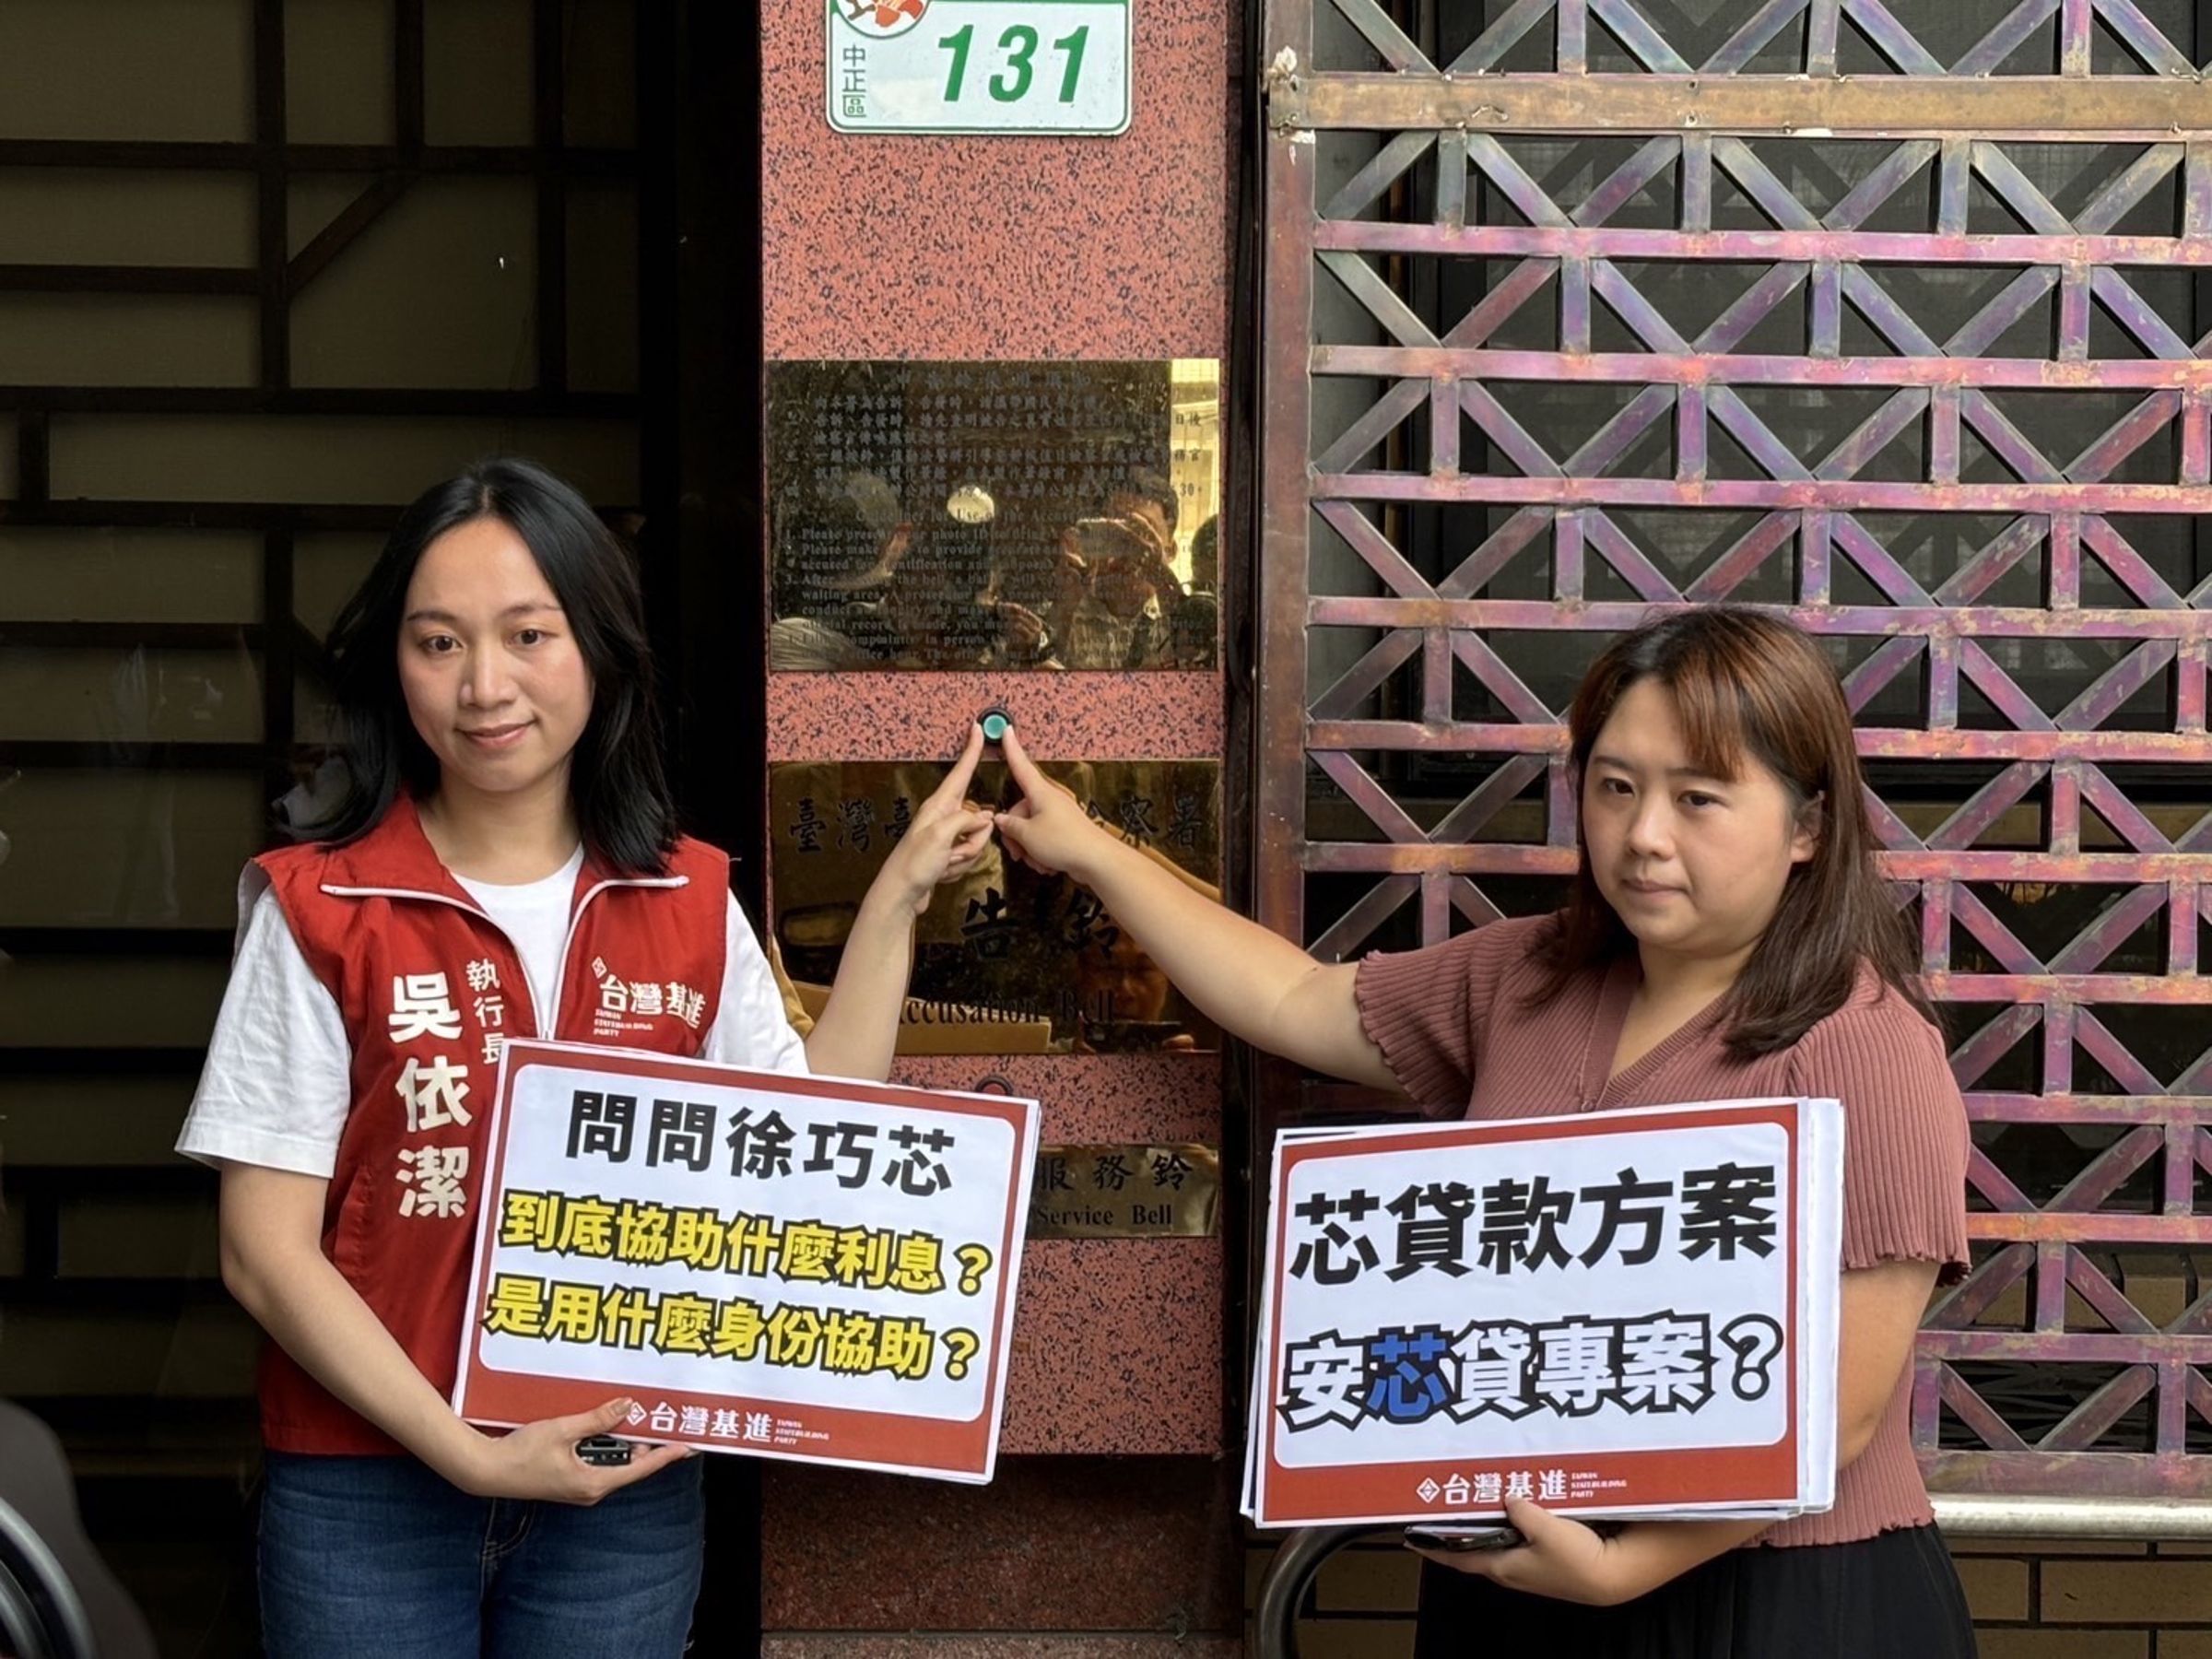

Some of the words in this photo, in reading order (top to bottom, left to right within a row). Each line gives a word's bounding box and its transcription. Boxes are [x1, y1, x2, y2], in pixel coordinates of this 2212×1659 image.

[841, 43, 867, 119] 中正區
[937, 24, 1089, 102] 131
[465, 959, 504, 1065] 執行長
[600, 973, 706, 1030] 台灣基進
[900, 989, 1041, 1024] ccusation
[388, 971, 474, 1219] 吳依潔
[565, 1089, 956, 1197] 問問徐巧芯
[1039, 1153, 1193, 1191] 服務鈴
[499, 1189, 994, 1297] 到底協助什麼利息？
[1037, 1205, 1114, 1226] Service
[1133, 1204, 1172, 1225] Bell
[1288, 1162, 1777, 1287] 芯貸款方案
[485, 1274, 981, 1382] 是用什麼身份協助？
[1277, 1310, 1784, 1433] 安芯貸專案？
[649, 1401, 772, 1443] 台灣基進
[1441, 1469, 1567, 1505] 台灣基進
